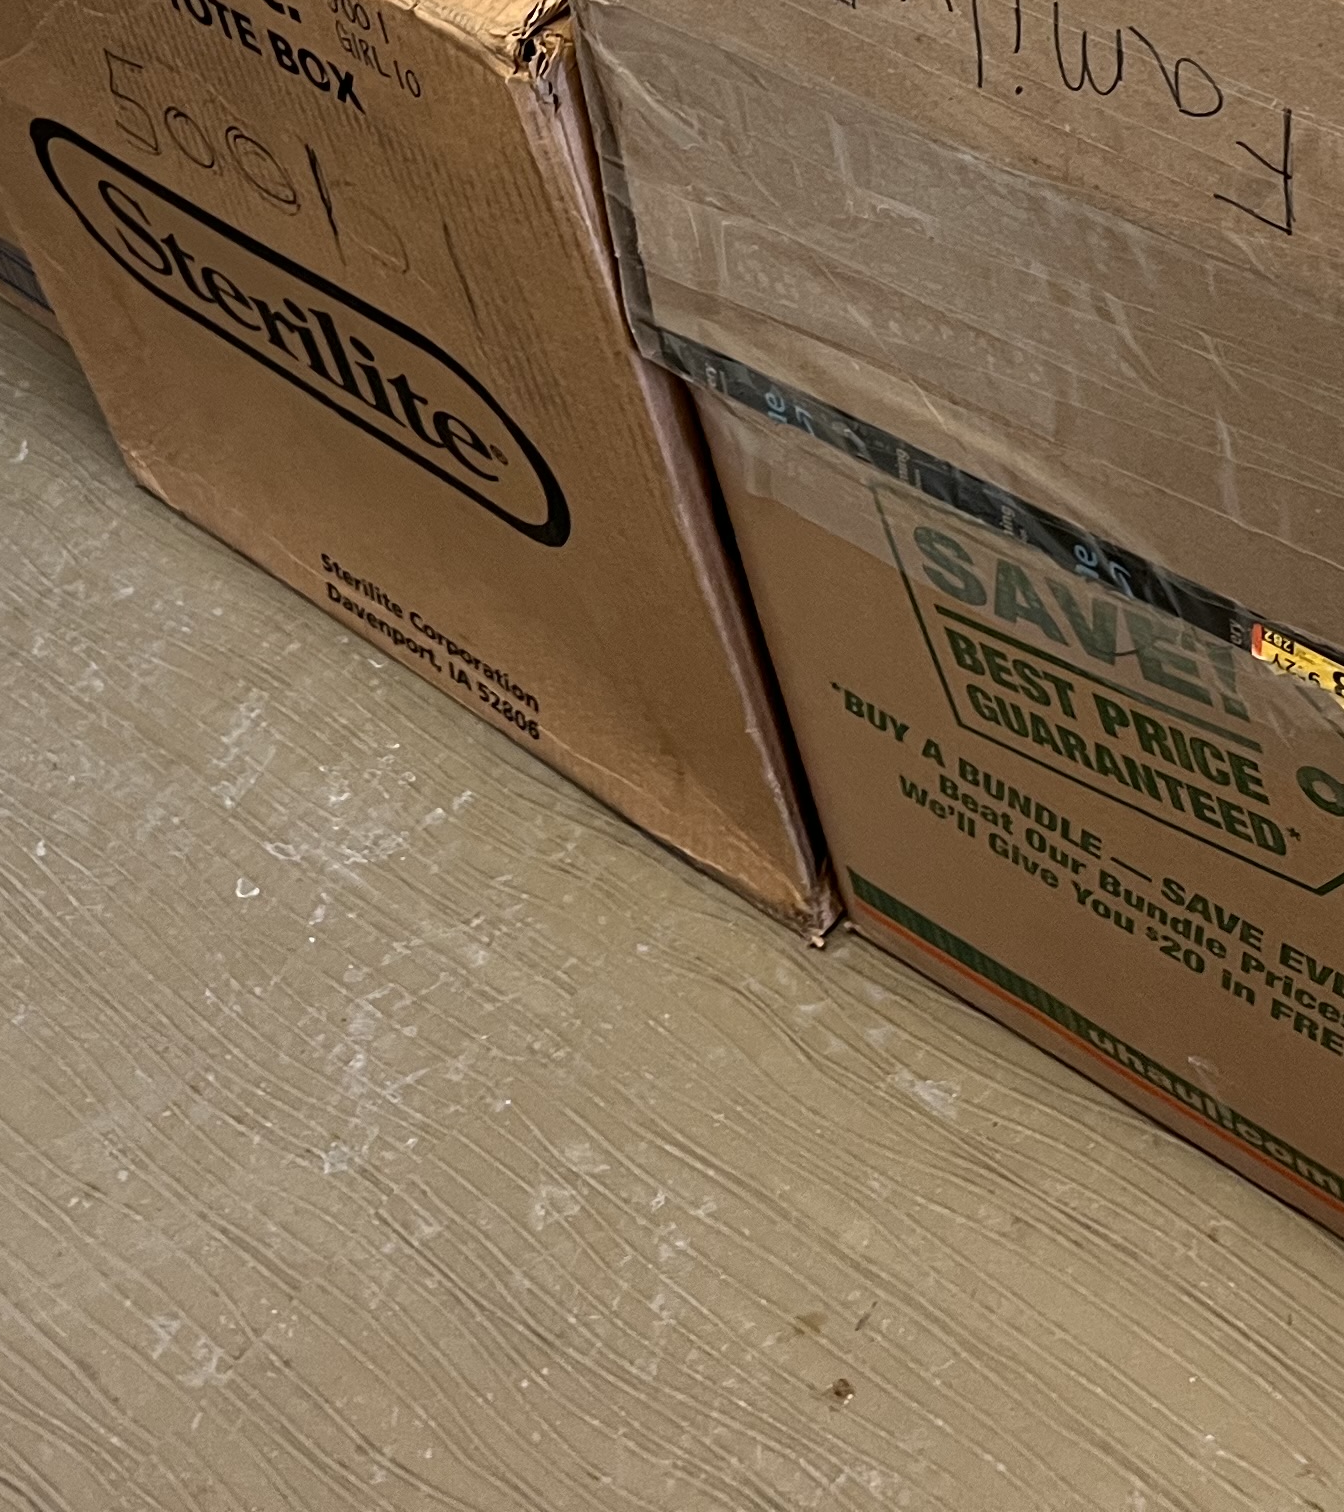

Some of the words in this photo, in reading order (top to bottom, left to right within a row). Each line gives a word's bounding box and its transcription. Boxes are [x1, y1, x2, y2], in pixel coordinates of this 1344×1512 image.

[268, 32, 367, 116] BOX
[393, 59, 422, 98] 10
[97, 179, 508, 482] Sterilite
[321, 552, 403, 619] Sterilite
[409, 611, 540, 714] Corporation
[325, 581, 443, 672] Davenport,
[448, 660, 473, 691] IA
[943, 626, 1077, 720] BEST
[1092, 692, 1271, 807] PRICE
[921, 738, 946, 769] A
[958, 756, 1103, 861] BUNDLE
[1160, 877, 1265, 953] SAVE
[939, 774, 1014, 836] Beat
[1025, 827, 1087, 877] Our
[1099, 868, 1227, 960] Bundle
[988, 832, 1059, 889] Give
[1071, 879, 1136, 935] You
[1221, 967, 1256, 1007] in
